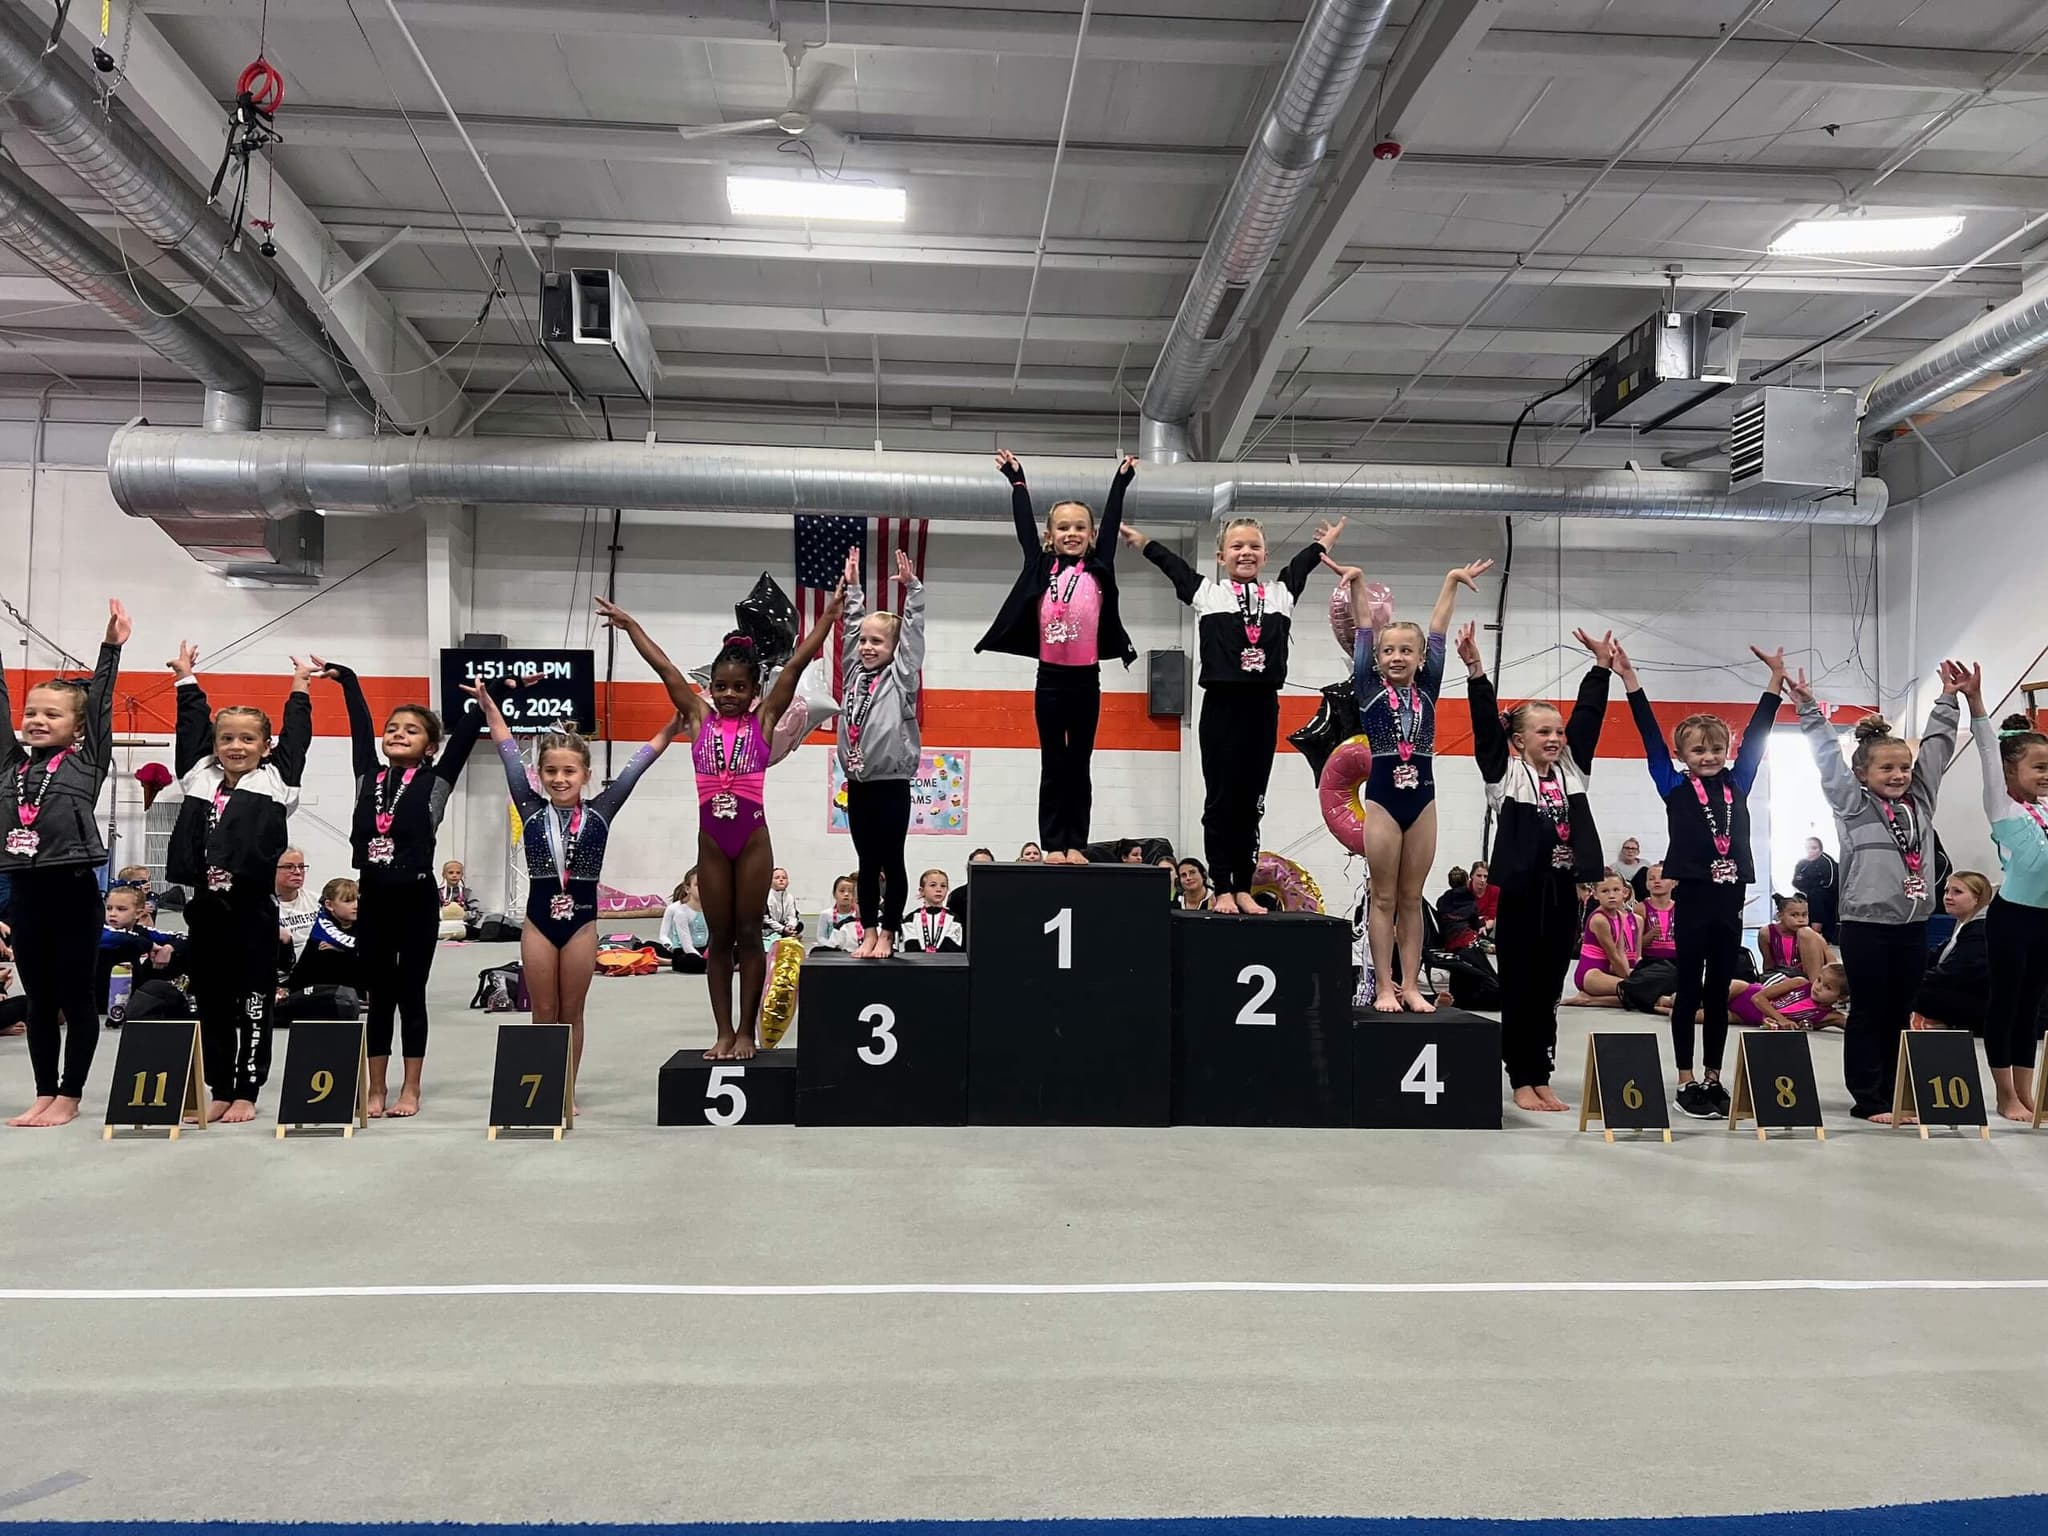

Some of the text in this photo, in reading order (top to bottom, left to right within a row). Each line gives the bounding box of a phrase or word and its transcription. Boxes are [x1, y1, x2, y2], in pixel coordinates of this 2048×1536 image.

[465, 661, 571, 679] 1:51:08 PM
[502, 698, 573, 719] 6, 2024
[910, 777, 937, 787] COME
[911, 795, 932, 804] AMS
[1044, 907, 1073, 969] 1
[1235, 964, 1277, 1026] 2
[857, 1003, 898, 1066] 3
[127, 1071, 168, 1107] 11
[307, 1071, 334, 1104] 9
[1400, 1043, 1445, 1105] 4
[519, 1074, 543, 1108] 7
[703, 1066, 747, 1126] 5
[1622, 1079, 1643, 1109] 6
[1775, 1076, 1797, 1107] 8
[1927, 1076, 1970, 1108] 10
